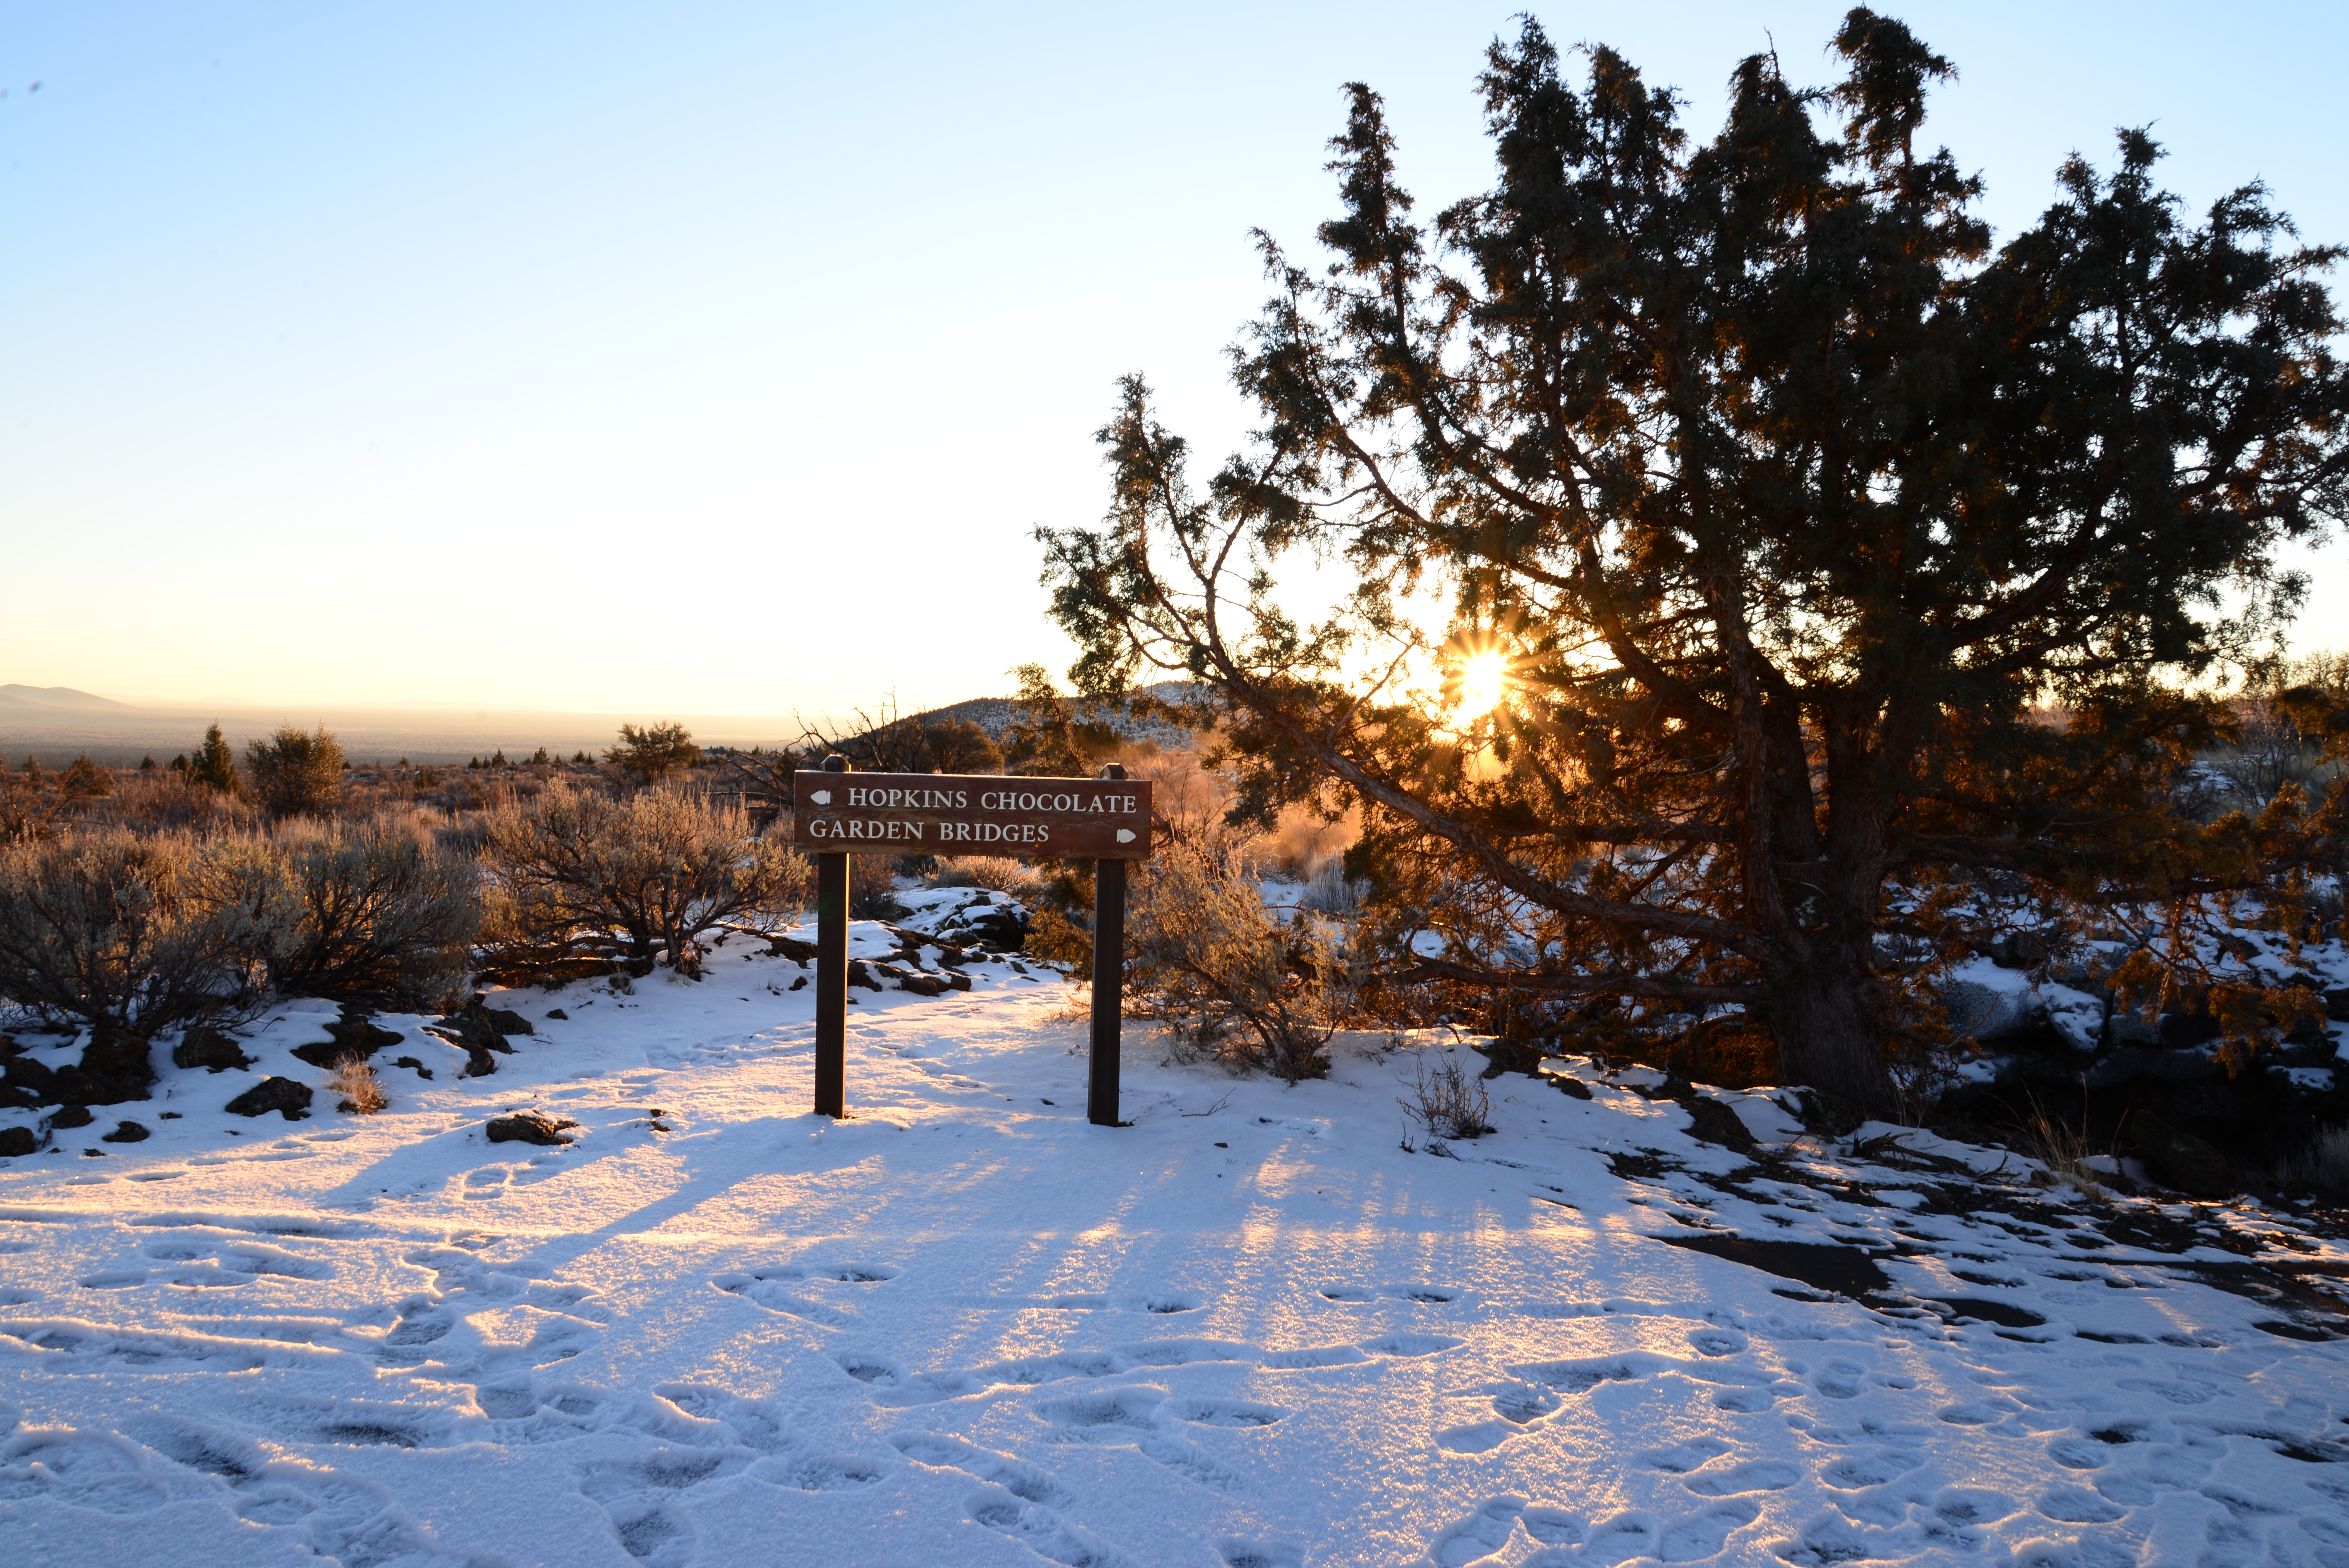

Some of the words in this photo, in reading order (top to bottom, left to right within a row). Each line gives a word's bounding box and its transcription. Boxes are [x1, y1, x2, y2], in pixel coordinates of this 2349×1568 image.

[848, 788, 967, 808] HOPKINS
[981, 792, 1136, 813] CHOCOLATE
[810, 820, 924, 839] GARDEN
[939, 823, 1048, 842] BRIDGES
